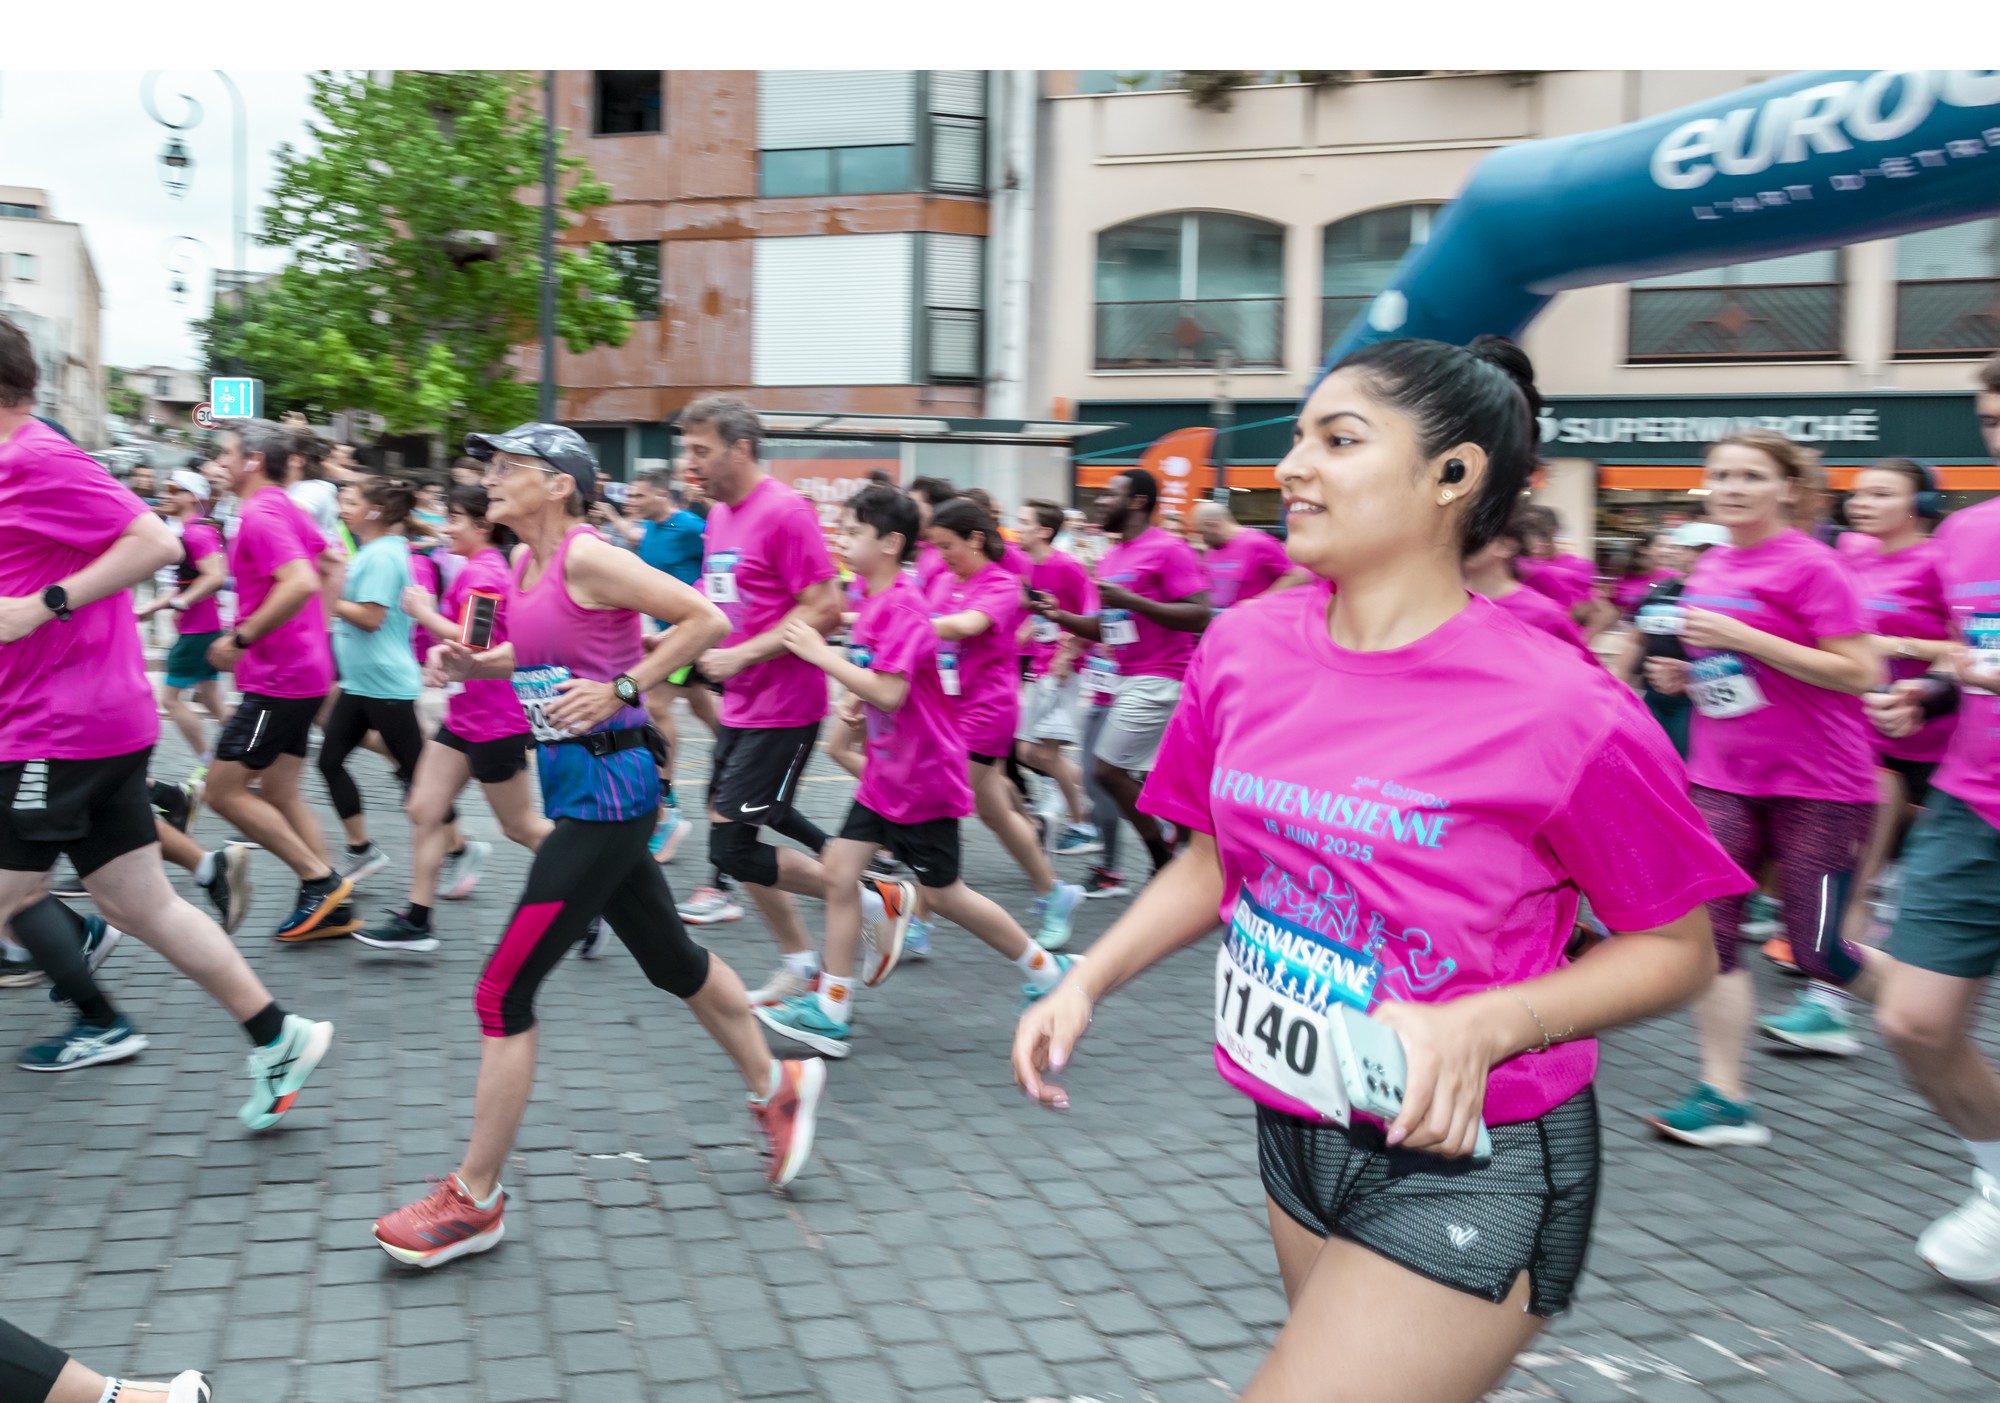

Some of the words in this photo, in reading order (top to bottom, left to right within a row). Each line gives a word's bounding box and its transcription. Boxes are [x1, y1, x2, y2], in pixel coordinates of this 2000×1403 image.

[1220, 769, 1453, 848] FONTENAISIENNE
[1380, 780, 1450, 810] ÉDITION
[1263, 817, 1279, 834] 15
[1284, 825, 1319, 847] JUIN
[1321, 834, 1374, 862] 2025
[1221, 967, 1319, 1077] 1140
